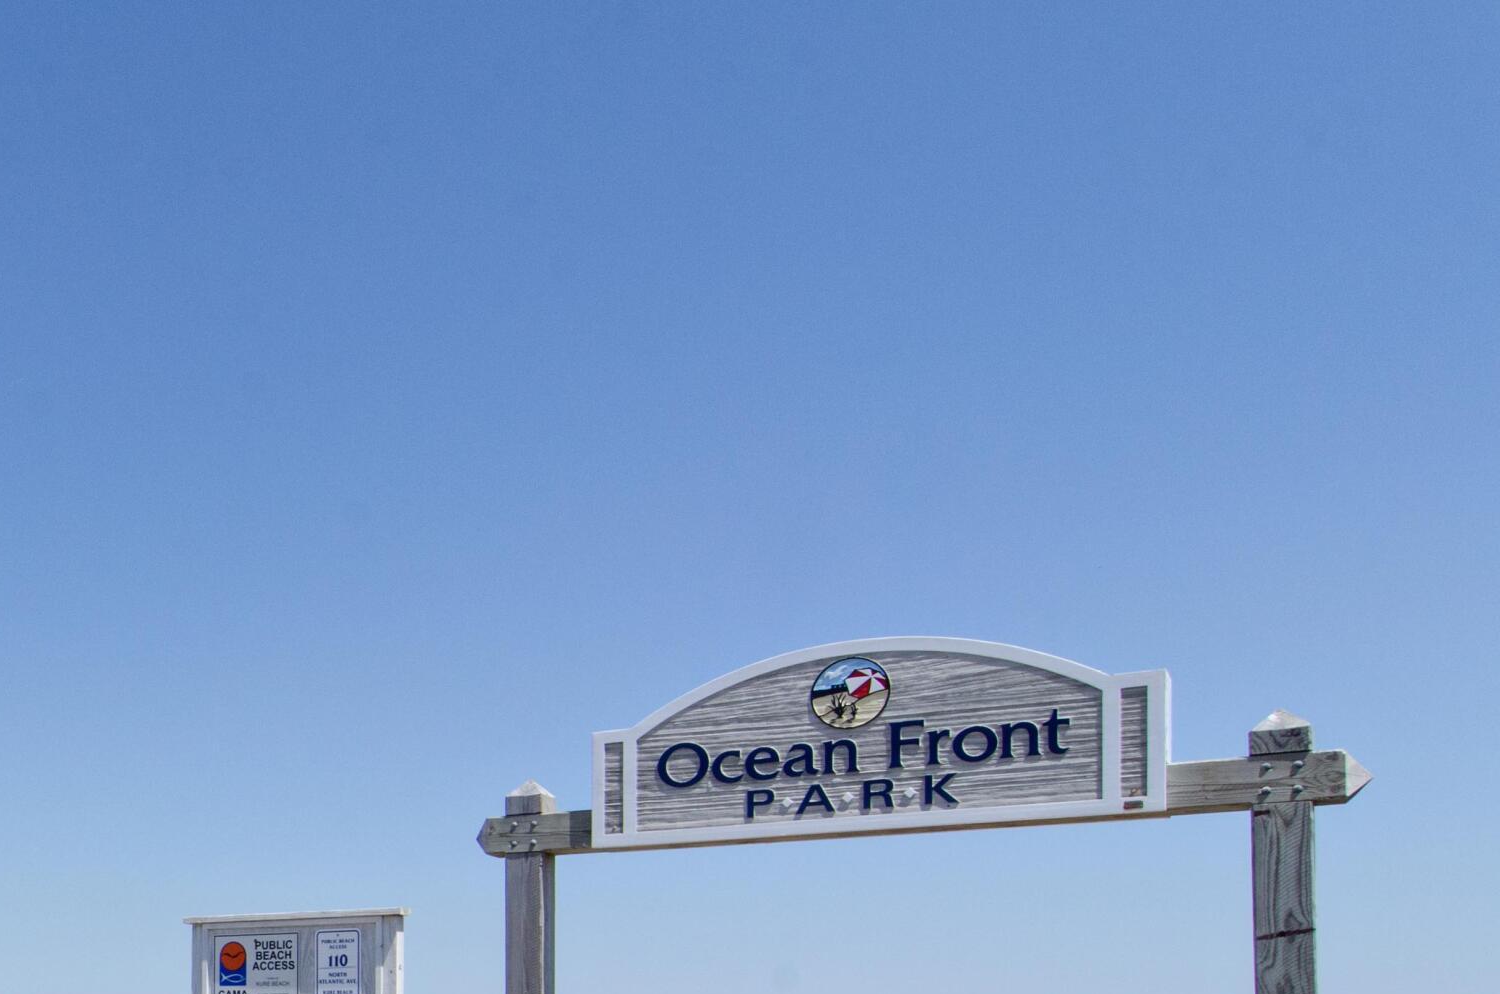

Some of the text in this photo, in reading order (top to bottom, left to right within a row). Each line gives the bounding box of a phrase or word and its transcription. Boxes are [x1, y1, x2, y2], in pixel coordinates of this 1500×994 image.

[657, 709, 1072, 788] Ocean Front
[255, 940, 293, 950] PUBLIC
[255, 951, 292, 960] BEACH
[328, 954, 348, 967] 110
[252, 961, 295, 971] ACCESS
